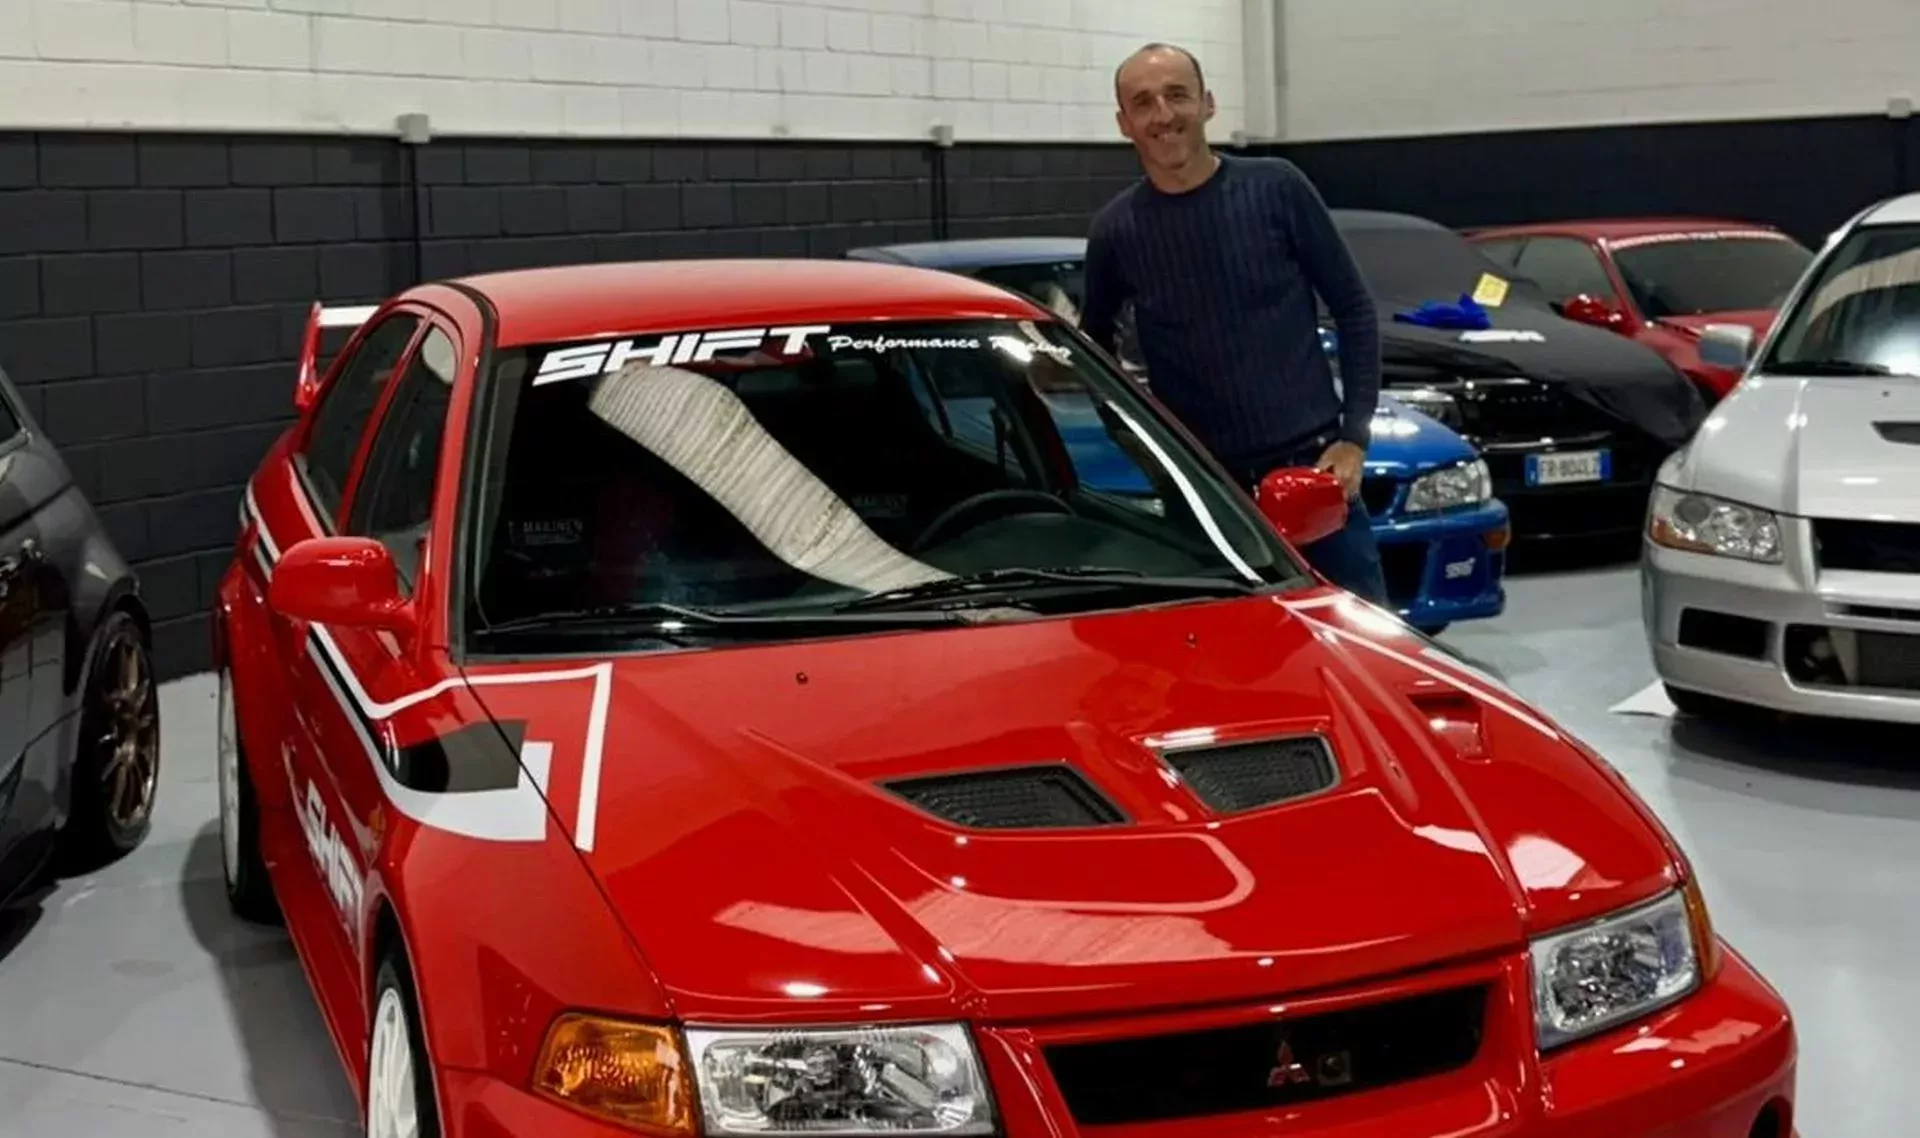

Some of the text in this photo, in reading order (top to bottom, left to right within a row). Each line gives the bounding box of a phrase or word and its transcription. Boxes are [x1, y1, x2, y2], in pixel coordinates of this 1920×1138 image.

[532, 325, 1071, 386] SHIFT Performance Rcing
